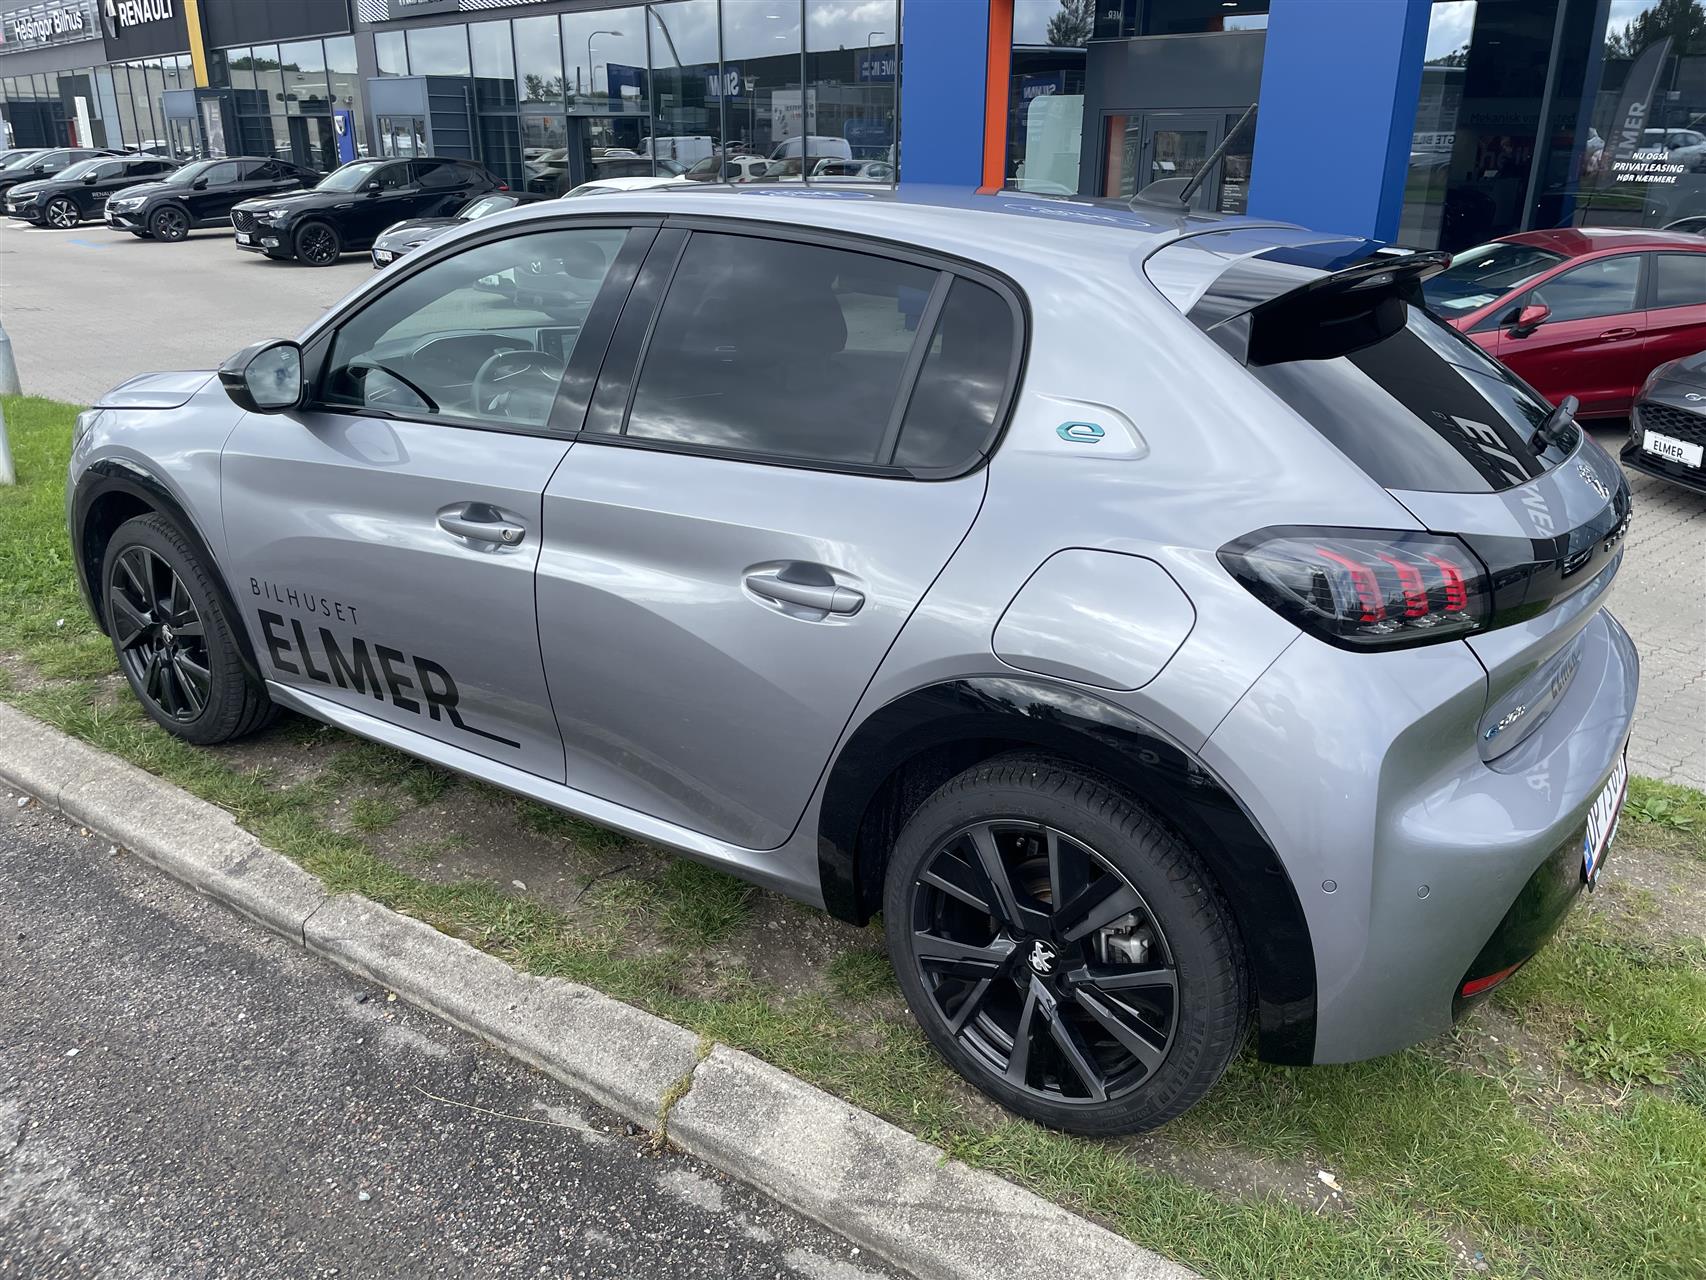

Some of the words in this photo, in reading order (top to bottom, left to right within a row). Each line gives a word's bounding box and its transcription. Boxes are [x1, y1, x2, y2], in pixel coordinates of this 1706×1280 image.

[1632, 152, 1646, 160] NU
[1646, 151, 1669, 160] OGSÅ
[1613, 162, 1685, 173] PRIVATLEASING
[1616, 173, 1635, 182] HØR
[1635, 175, 1677, 184] NÆRMERE
[1653, 440, 1684, 458] ELMER
[250, 577, 358, 625] BILHUSET
[257, 608, 521, 749] ELMER
